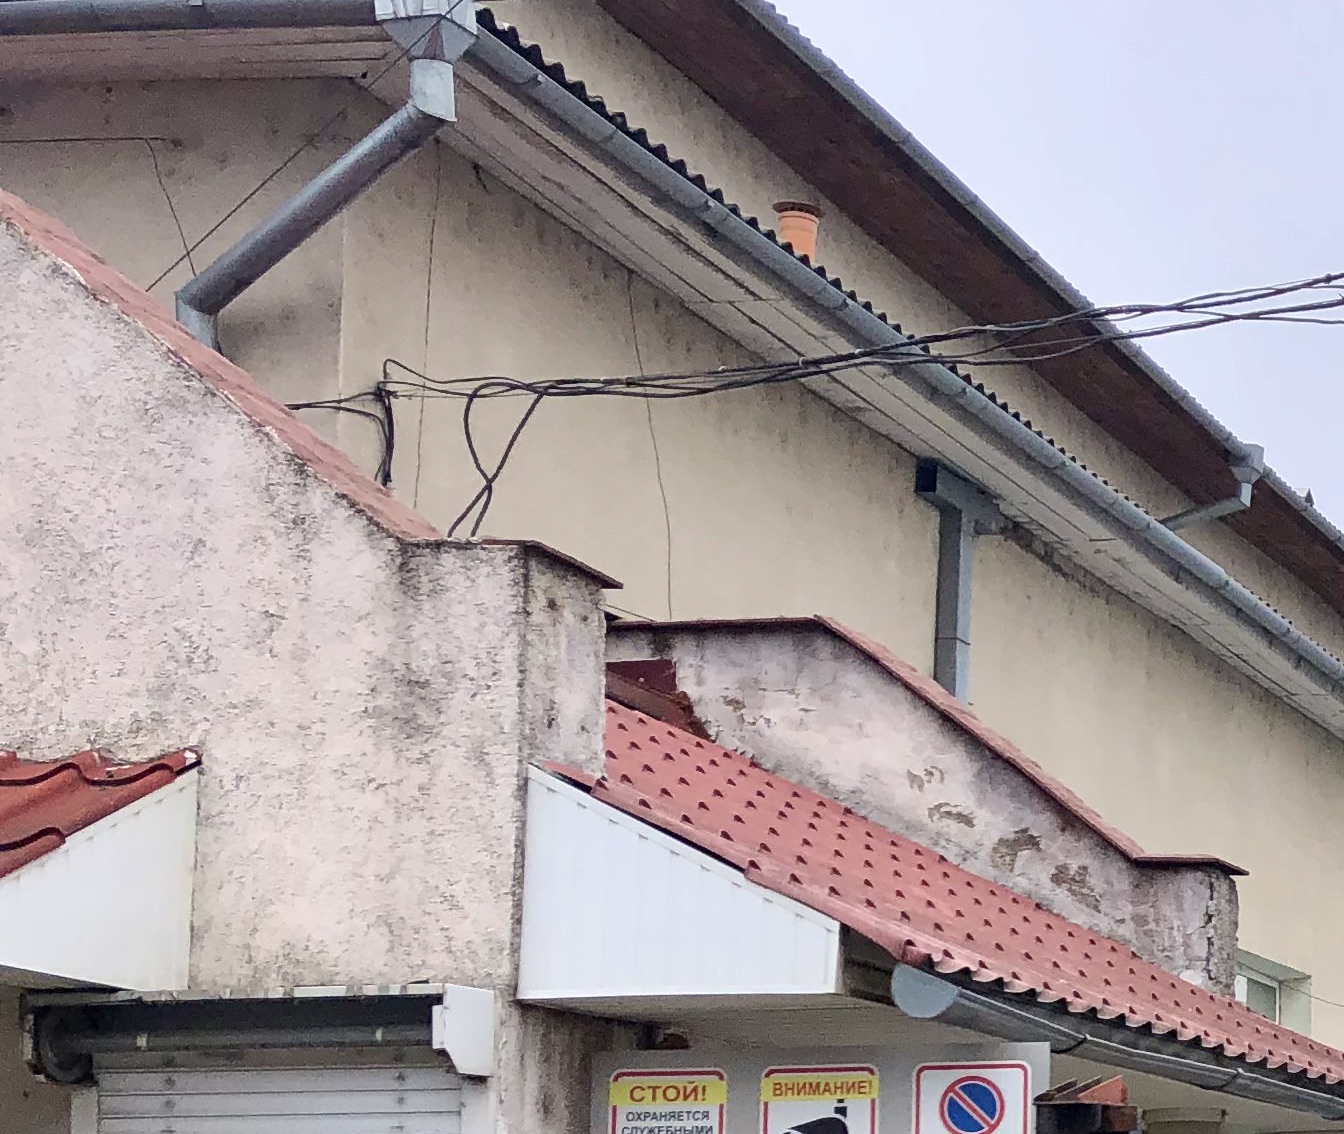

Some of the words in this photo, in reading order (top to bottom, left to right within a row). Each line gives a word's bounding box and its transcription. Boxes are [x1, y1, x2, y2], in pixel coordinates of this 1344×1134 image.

[629, 1081, 707, 1102] СТОЙ!
[772, 1081, 873, 1097] ВНИМАНИЕ!
[625, 1111, 710, 1122] ОХРАНЯЕТСЯ
